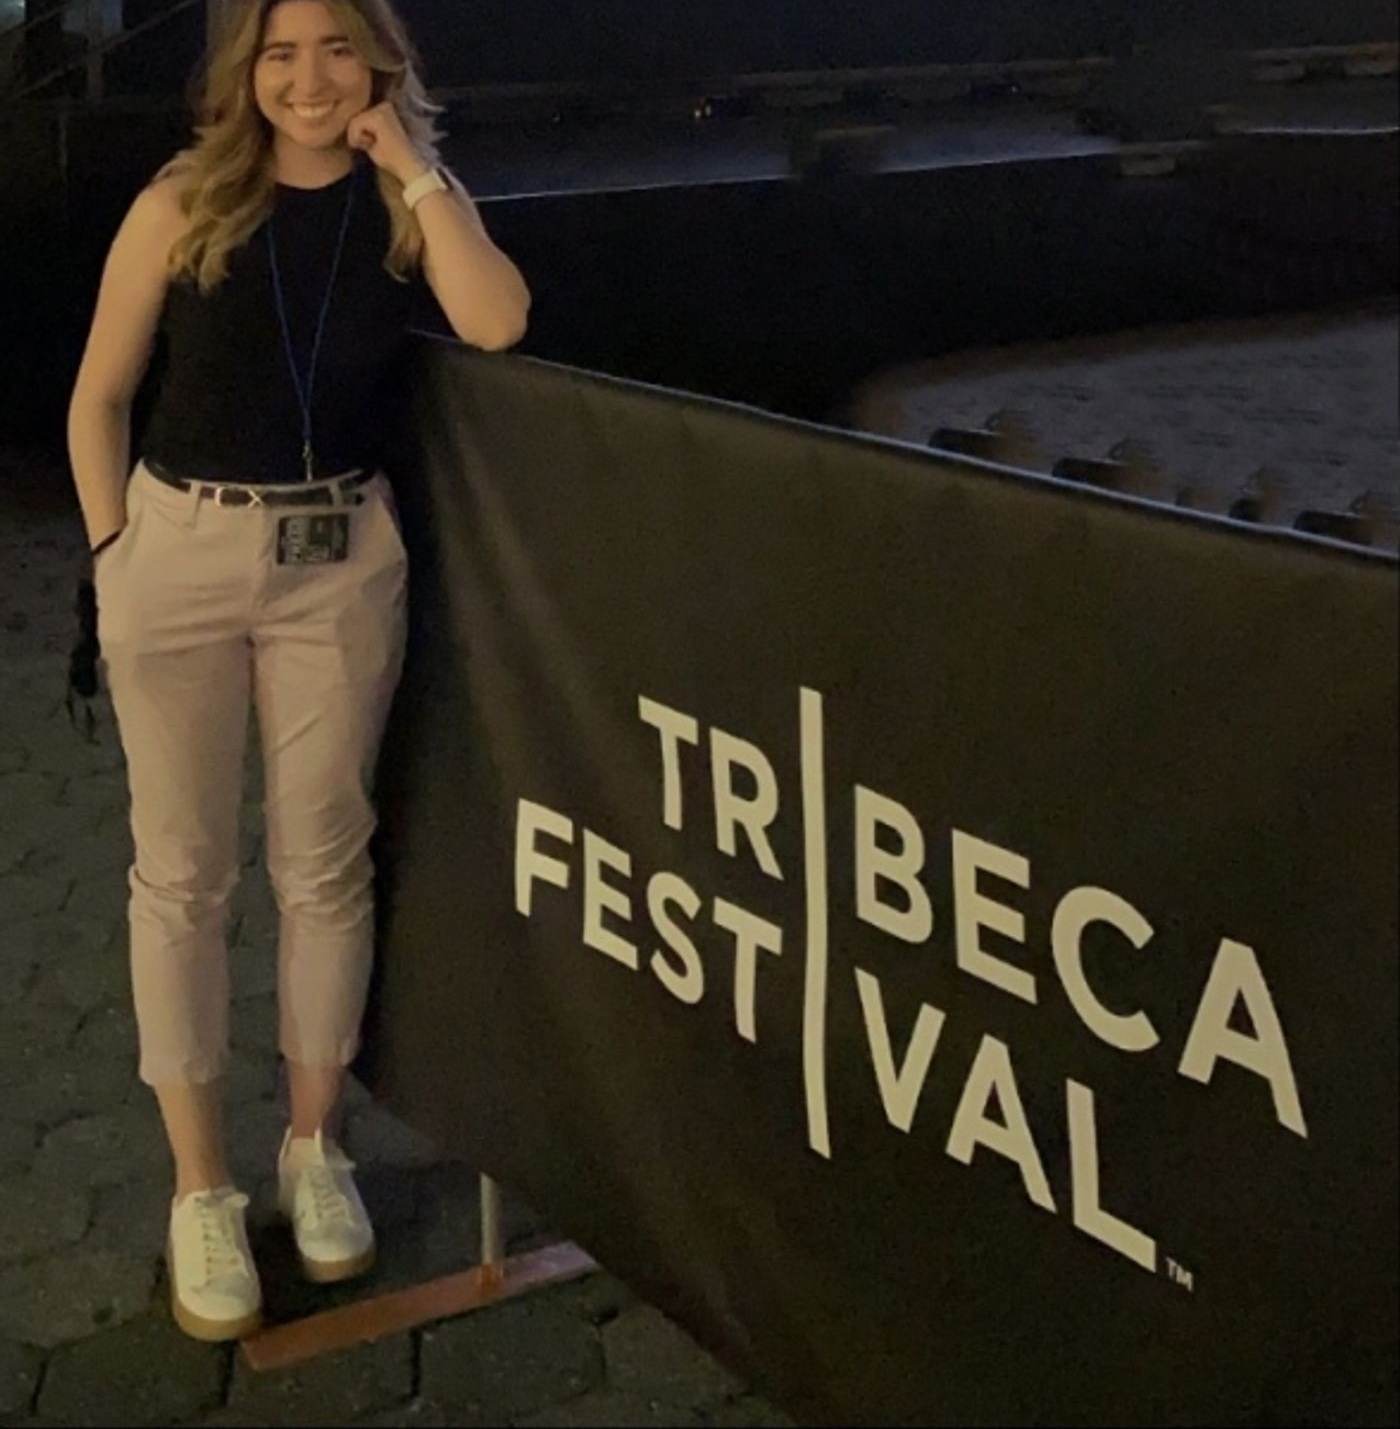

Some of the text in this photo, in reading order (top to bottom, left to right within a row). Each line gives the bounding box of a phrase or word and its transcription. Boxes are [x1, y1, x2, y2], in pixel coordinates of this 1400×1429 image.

[514, 798, 1156, 1273] FESTIVAL
[637, 693, 1308, 1139] TRIBECA
[1164, 1257, 1193, 1292] TM
